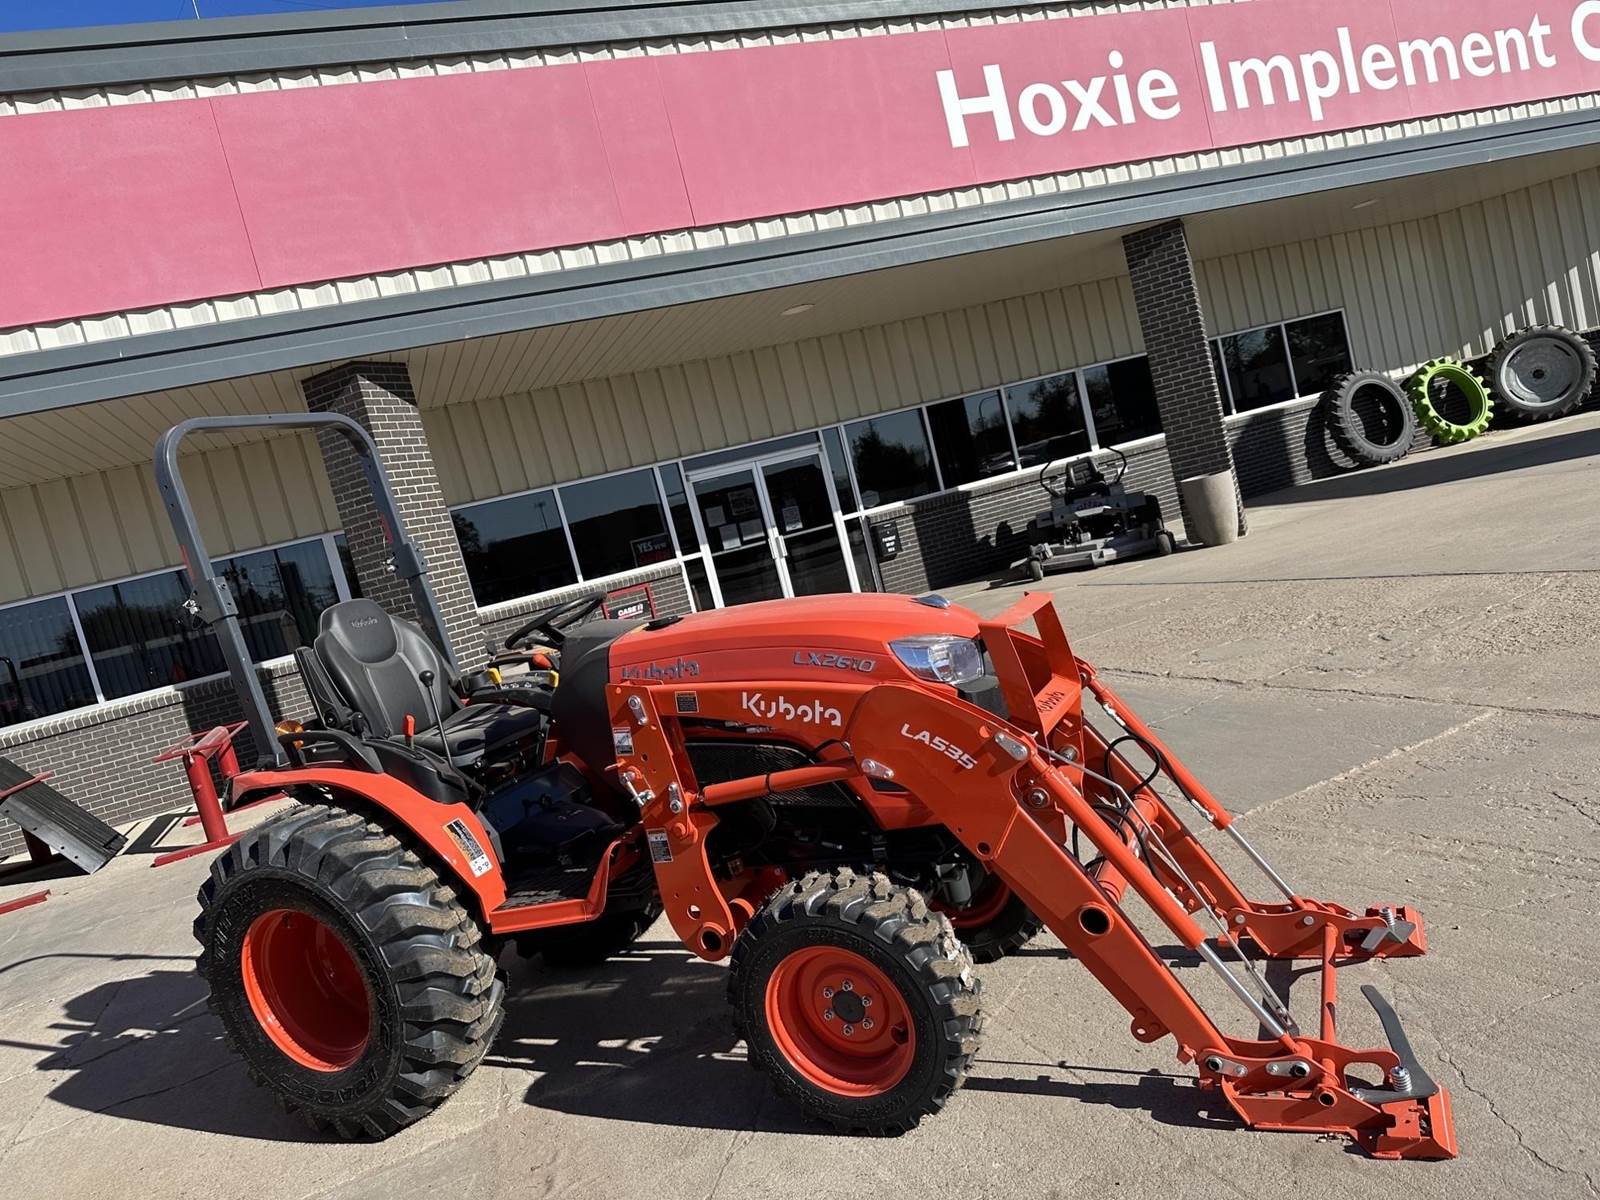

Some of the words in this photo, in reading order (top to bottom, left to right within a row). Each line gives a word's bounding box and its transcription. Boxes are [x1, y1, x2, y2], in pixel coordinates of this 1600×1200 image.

[936, 50, 1181, 148] Hoxie
[1200, 13, 1556, 121] Implement
[618, 606, 637, 616] CASE
[793, 651, 876, 672] LX2610
[742, 691, 841, 726] Kubota
[901, 723, 978, 769] LA535
